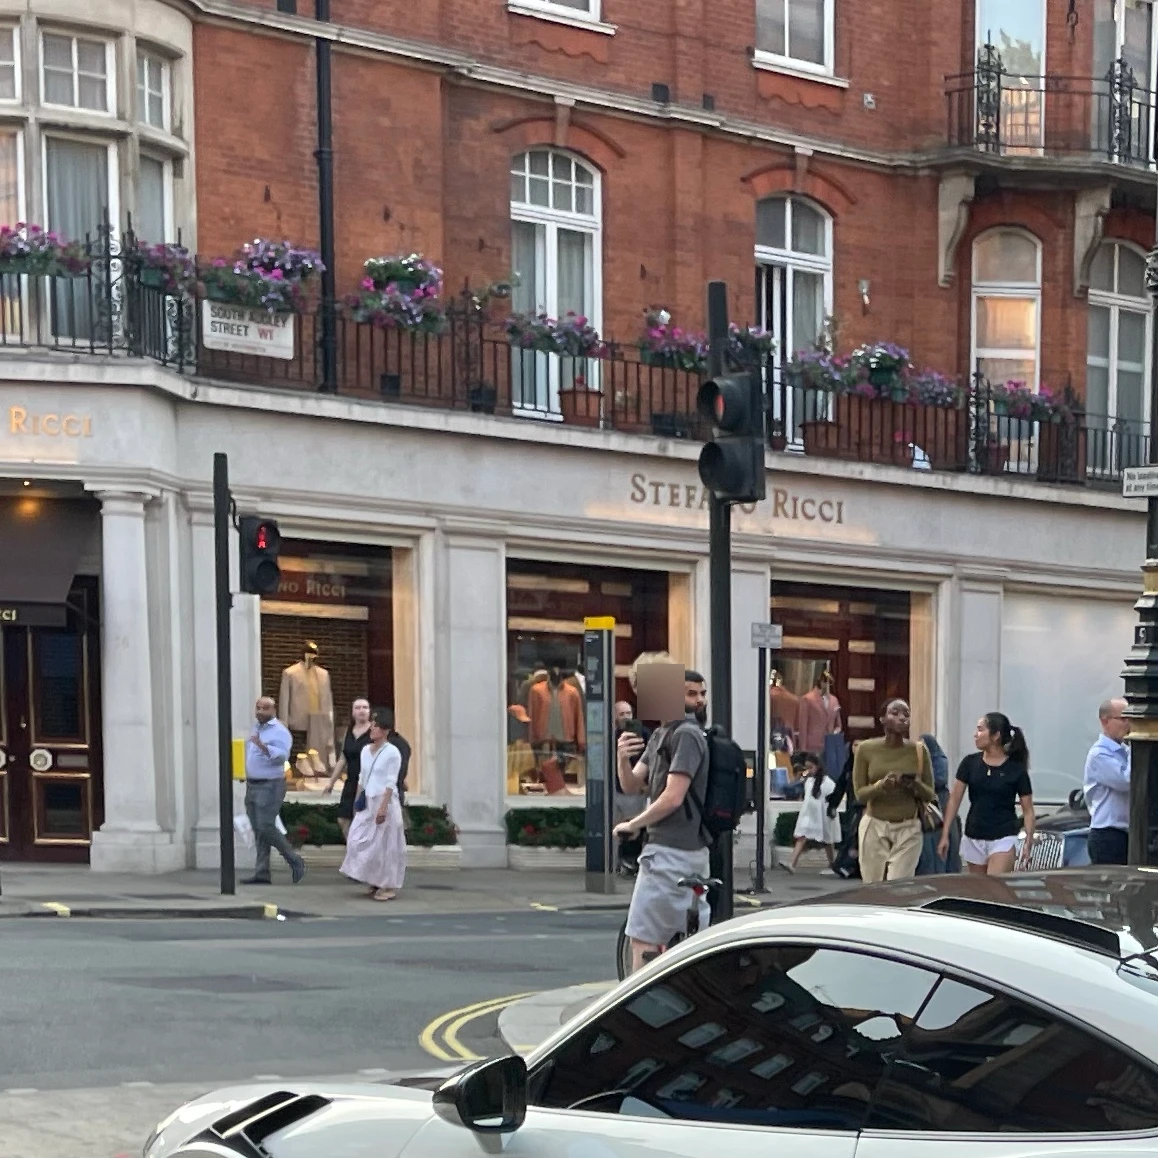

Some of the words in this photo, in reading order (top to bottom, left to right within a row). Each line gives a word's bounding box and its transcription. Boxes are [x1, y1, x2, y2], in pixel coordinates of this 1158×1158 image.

[210, 304, 245, 322] SOUTH
[210, 320, 250, 337] STREET
[257, 326, 274, 341] W1
[9, 404, 94, 437] RICCI
[630, 472, 757, 516] STEFA
[772, 487, 844, 524] RICCI
